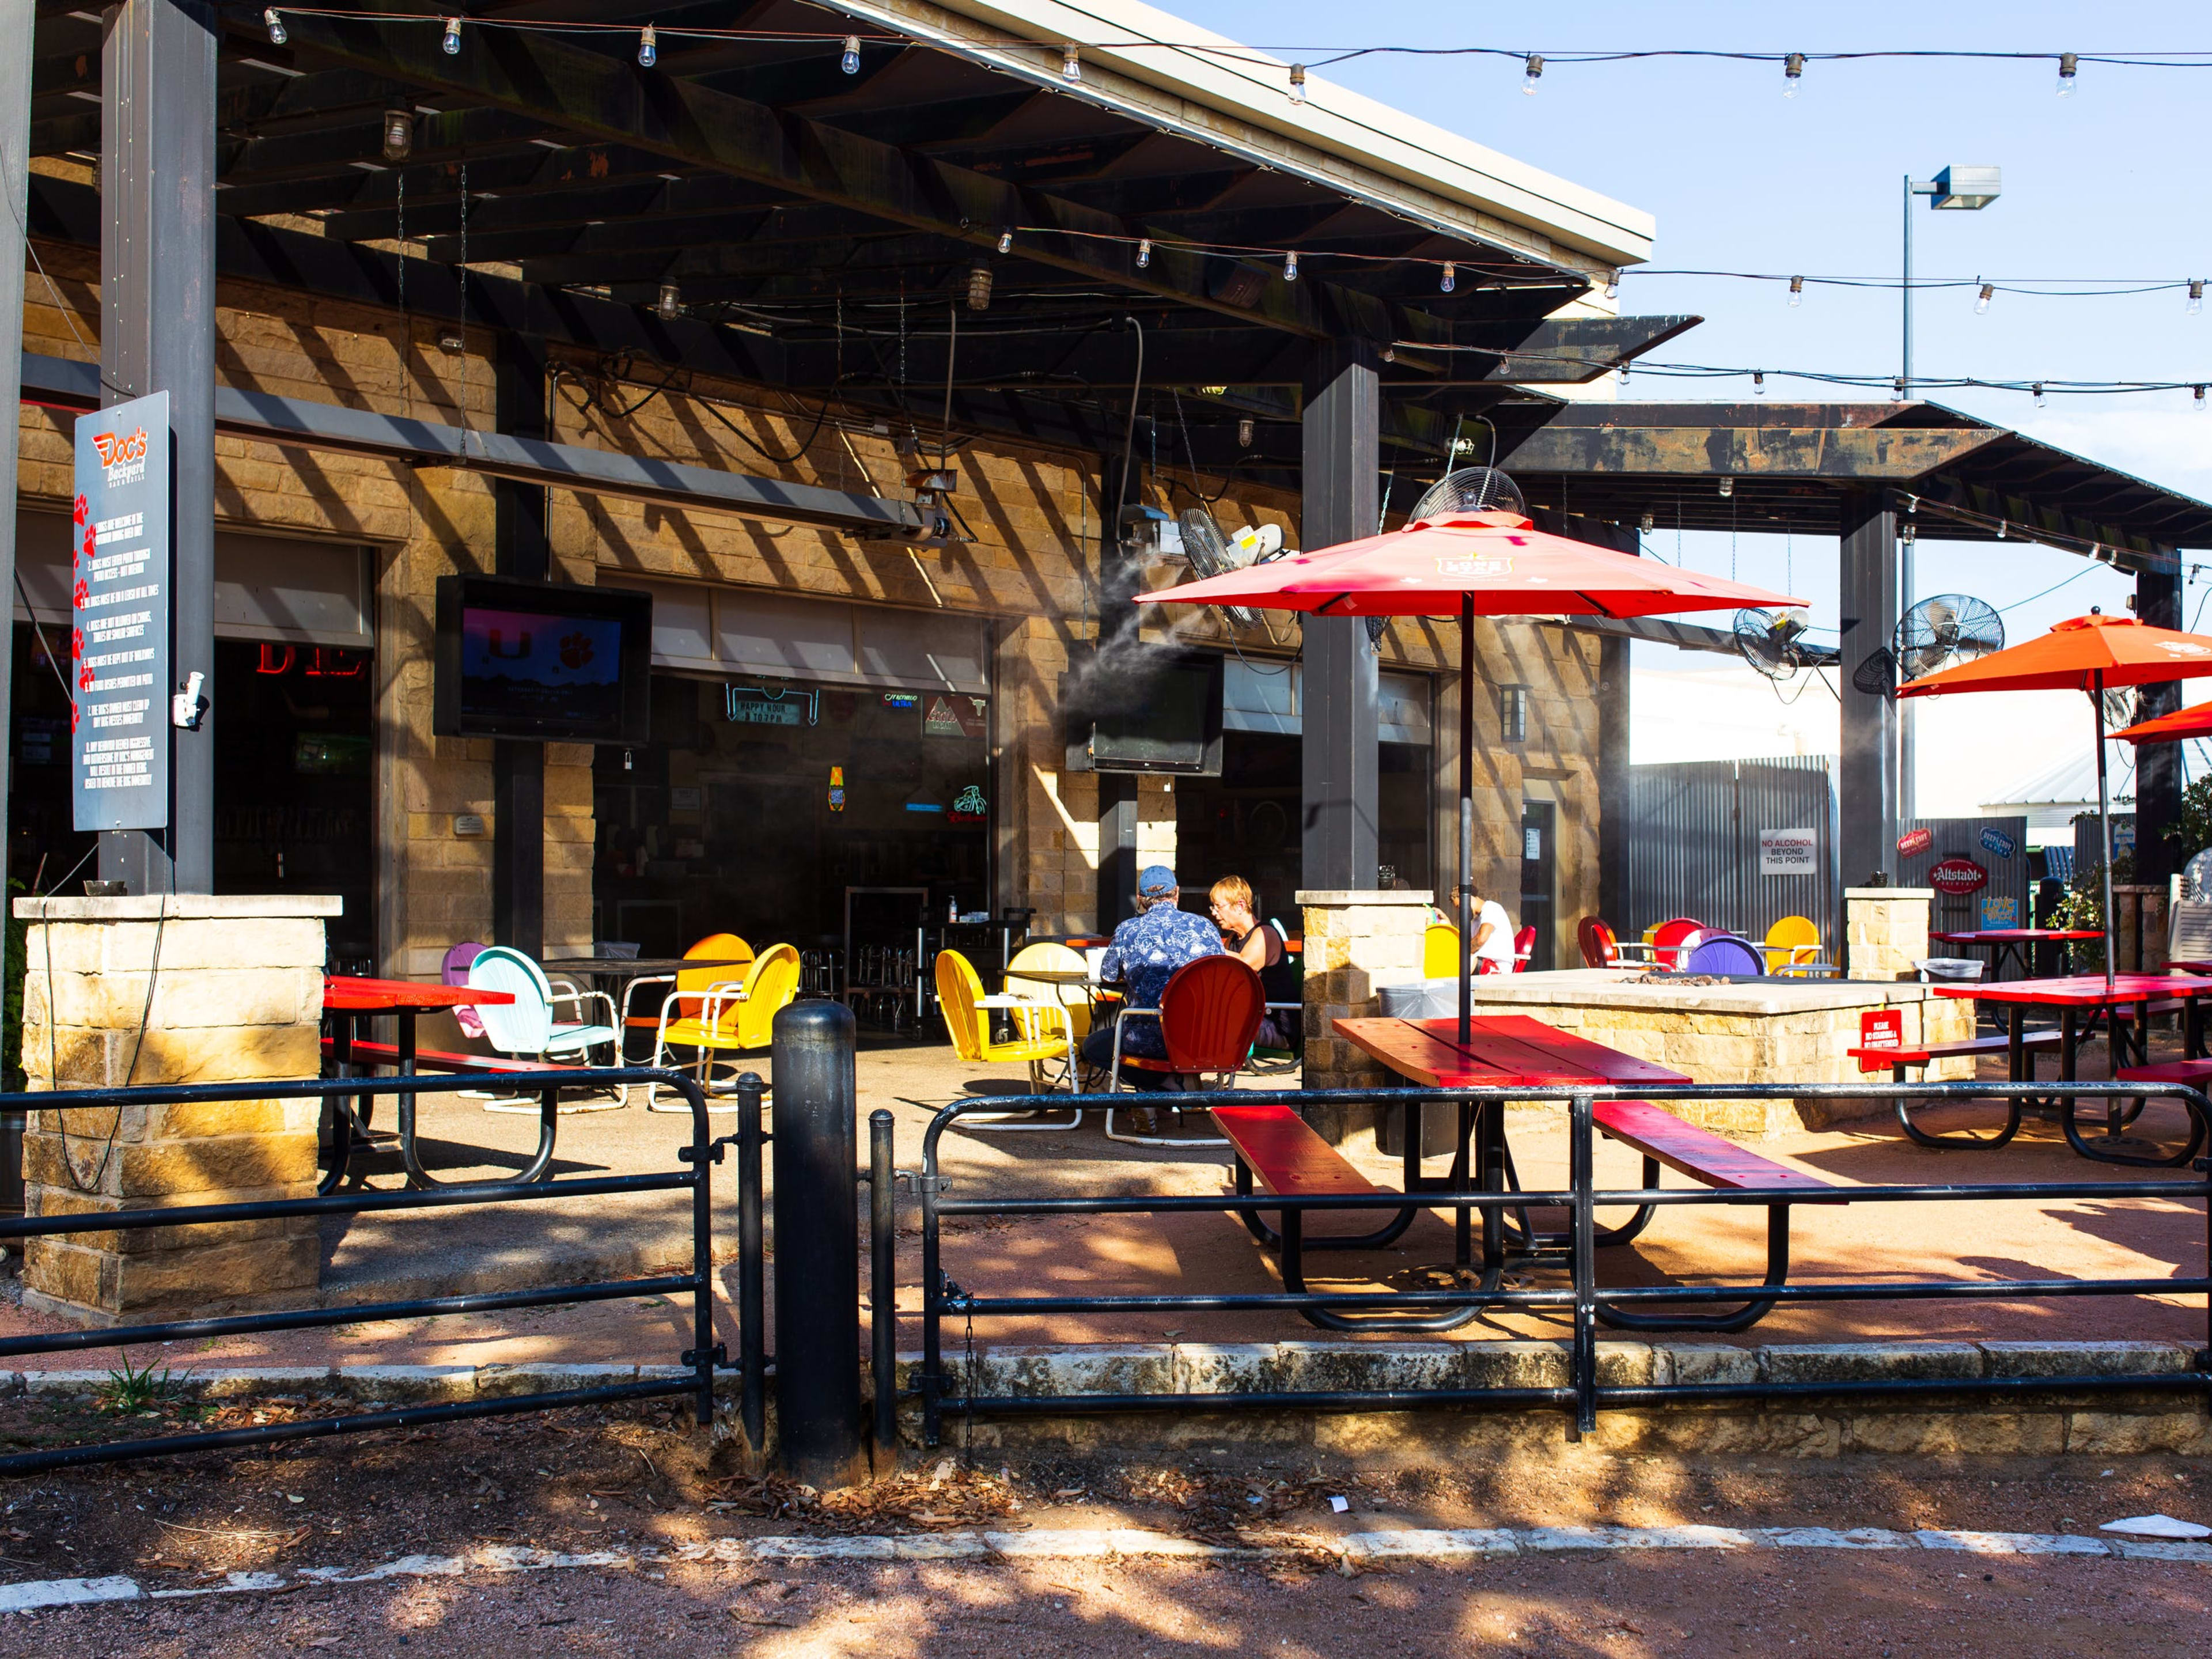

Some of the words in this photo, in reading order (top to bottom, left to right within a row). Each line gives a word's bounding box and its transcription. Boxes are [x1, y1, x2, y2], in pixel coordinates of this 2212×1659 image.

[108, 458, 146, 482] Backyard
[740, 701, 764, 712] HAPPY
[767, 703, 785, 714] HOUR
[927, 710, 958, 723] Coors
[1762, 839, 1773, 847] NO
[1775, 839, 1814, 847] ALCOHOL
[1771, 848, 1804, 856] BEYOND
[1766, 857, 1783, 865] THIS
[1785, 856, 1810, 864] POINT
[1936, 867, 1978, 882] Altstadt
[1873, 1021, 1889, 1031] PLEASE
[1865, 1032, 1872, 1041] NO
[1872, 1031, 1893, 1040] STANDING
